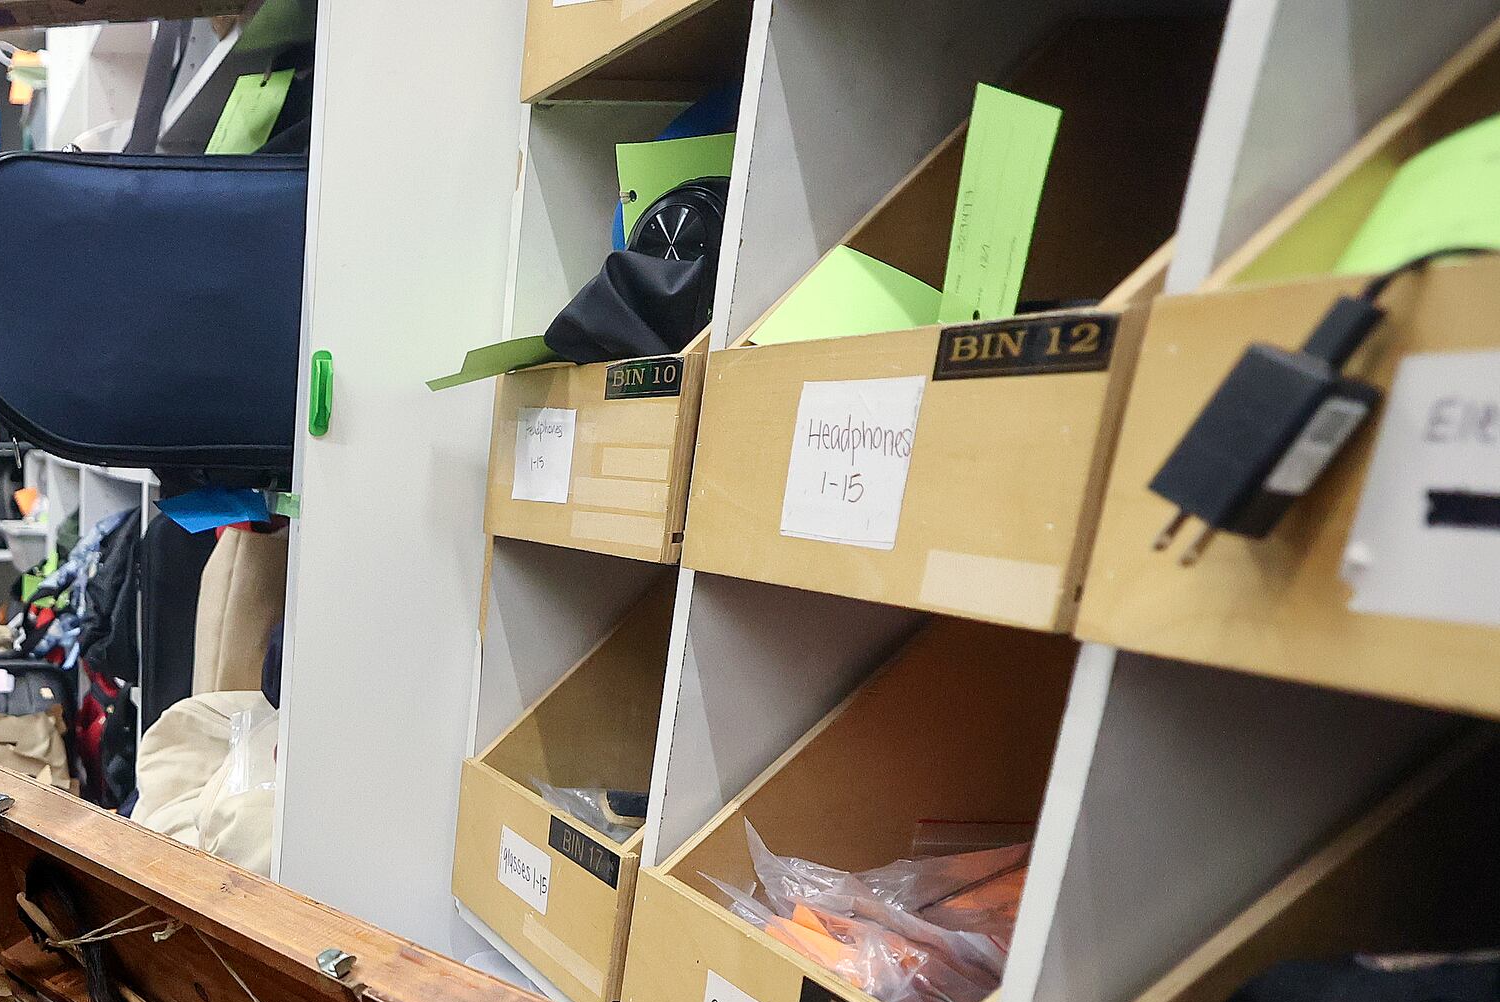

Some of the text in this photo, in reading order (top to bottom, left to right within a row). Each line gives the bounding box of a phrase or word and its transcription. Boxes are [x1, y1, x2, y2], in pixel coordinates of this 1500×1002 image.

[949, 322, 1100, 362] BIN 12
[611, 365, 677, 388] BIN 10
[808, 413, 913, 466] Headphones
[530, 456, 545, 471] 1-15
[821, 471, 864, 503] 1-15
[562, 828, 605, 872] BIN 17
[503, 847, 548, 897] glasses 1-15
